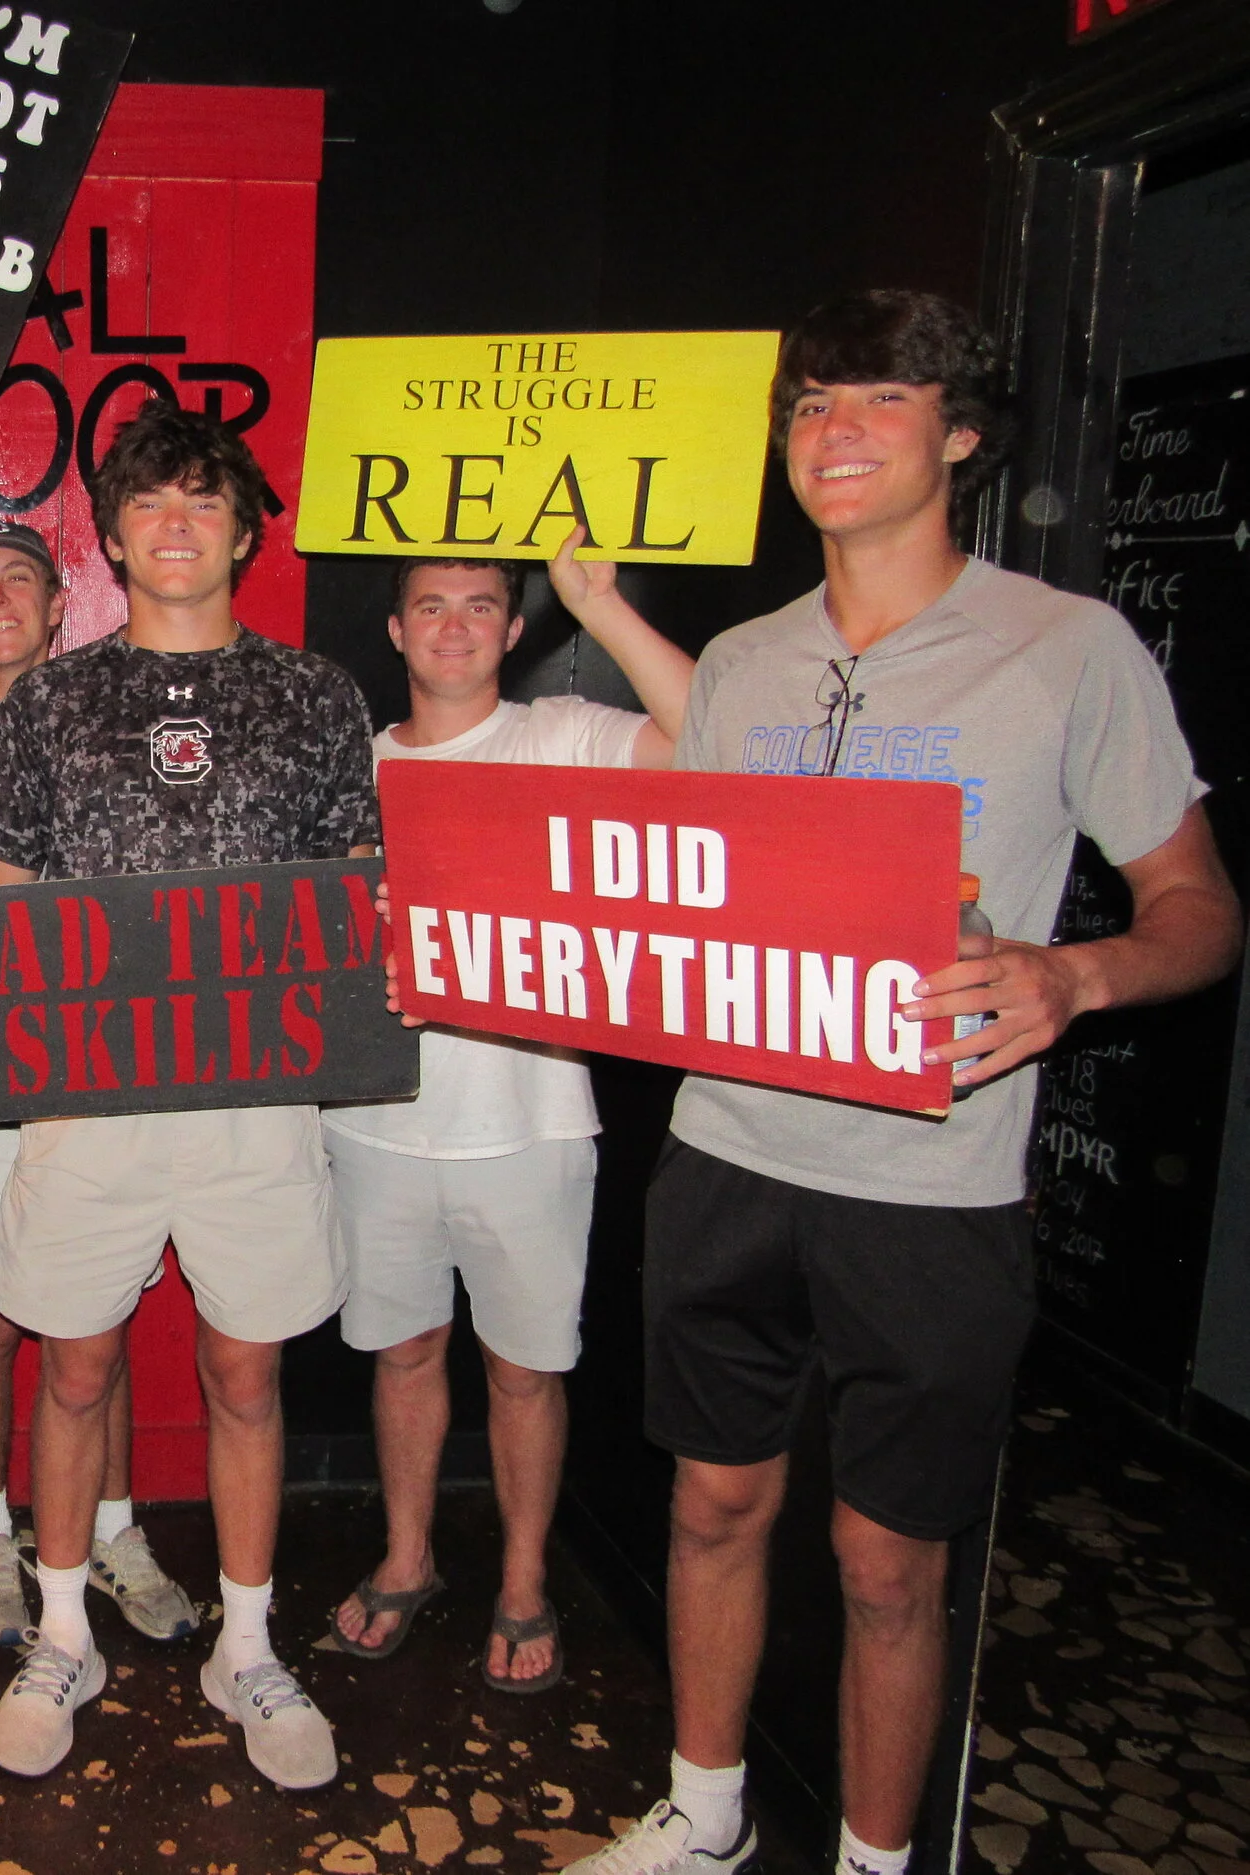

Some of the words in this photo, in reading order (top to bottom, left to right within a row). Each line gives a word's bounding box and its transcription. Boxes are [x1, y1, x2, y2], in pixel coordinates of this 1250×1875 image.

[403, 377, 657, 411] STRUGGLE
[487, 342, 578, 374] THE
[504, 415, 543, 448] IS
[1120, 405, 1193, 462] Time
[341, 453, 697, 553] REAL
[1106, 459, 1230, 527] erboard
[548, 816, 572, 895] I
[591, 818, 727, 911] DID
[152, 873, 391, 984] TEAM
[406, 904, 925, 1076] EVERYTHING
[3, 983, 325, 1097] SKILLS
